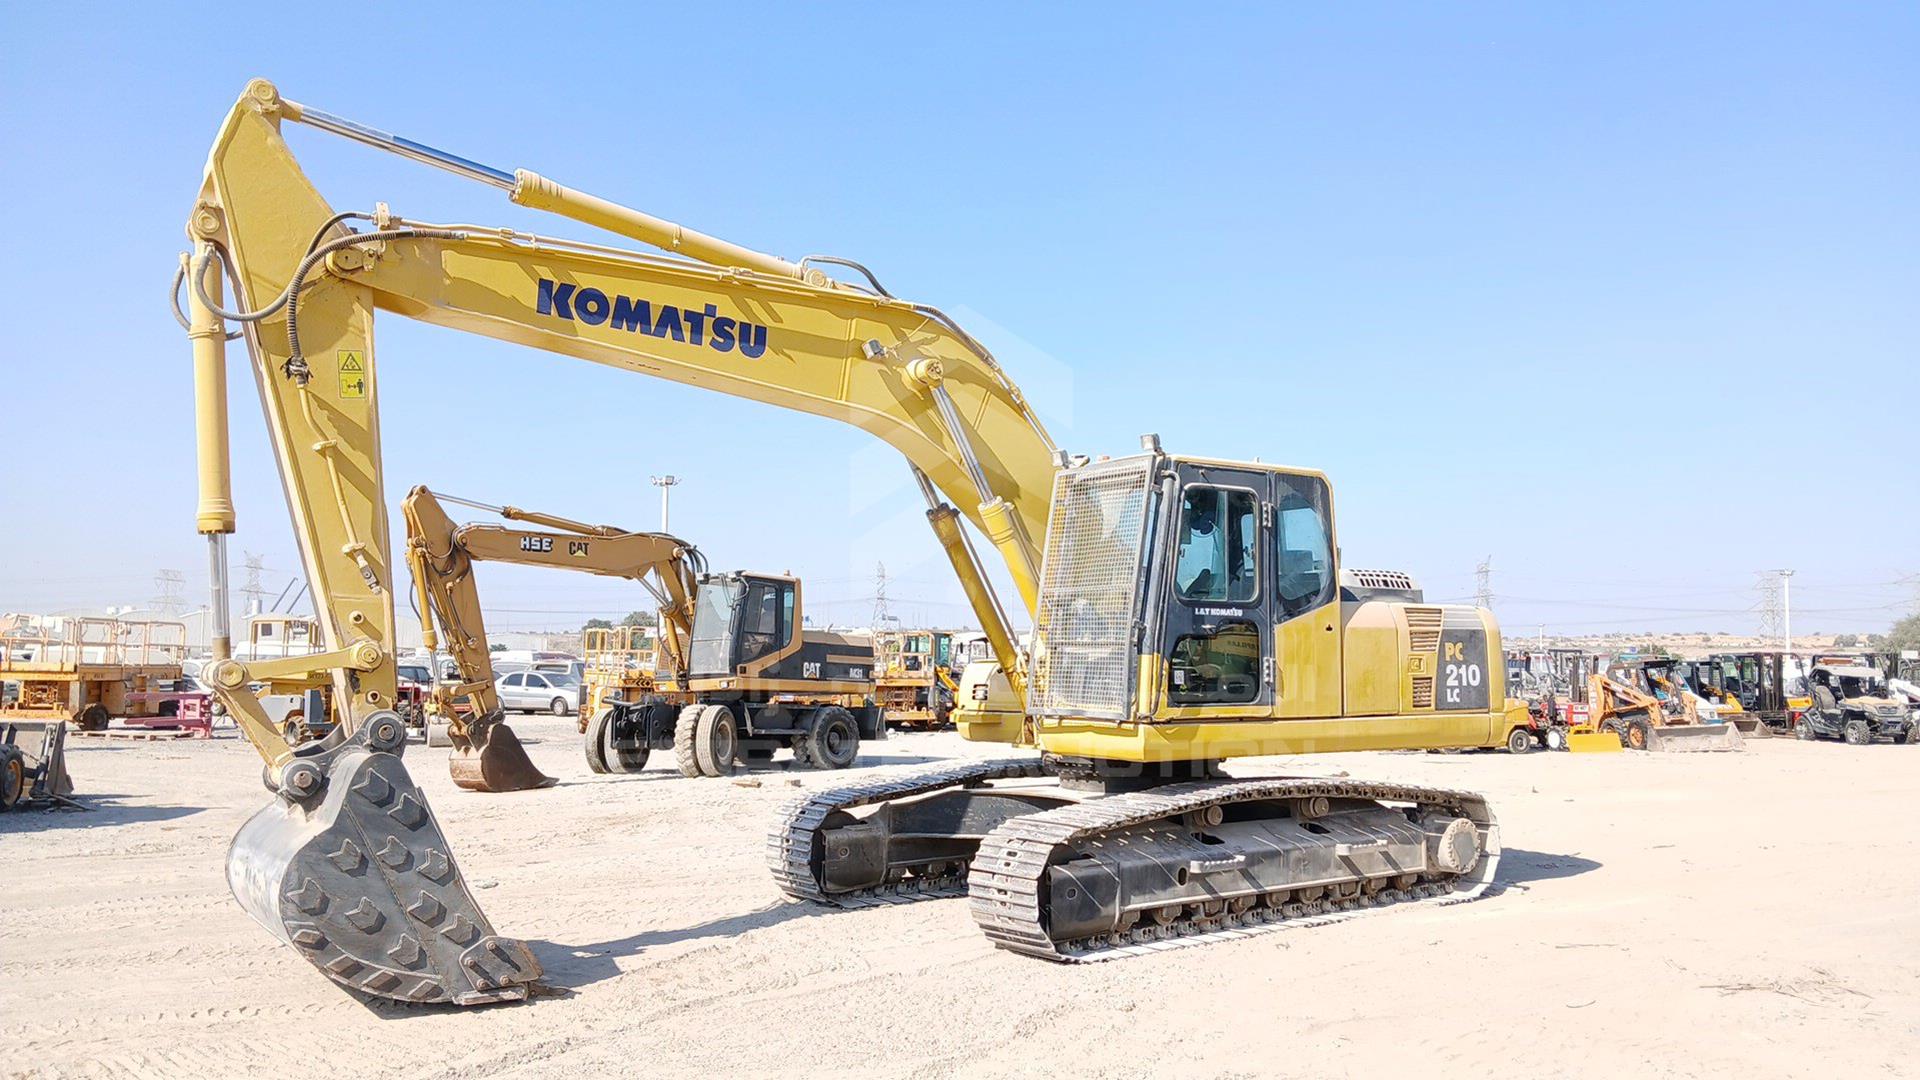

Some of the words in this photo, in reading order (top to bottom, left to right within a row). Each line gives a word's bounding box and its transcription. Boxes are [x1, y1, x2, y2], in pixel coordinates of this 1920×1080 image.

[536, 278, 768, 359] KOMATSU
[520, 536, 553, 552] HSE
[568, 541, 590, 556] CAT
[1210, 607, 1243, 617] KOMATSU
[1445, 642, 1464, 661] PC
[803, 662, 821, 678] CAT
[1446, 664, 1480, 686] 210
[1446, 688, 1460, 702] LC
